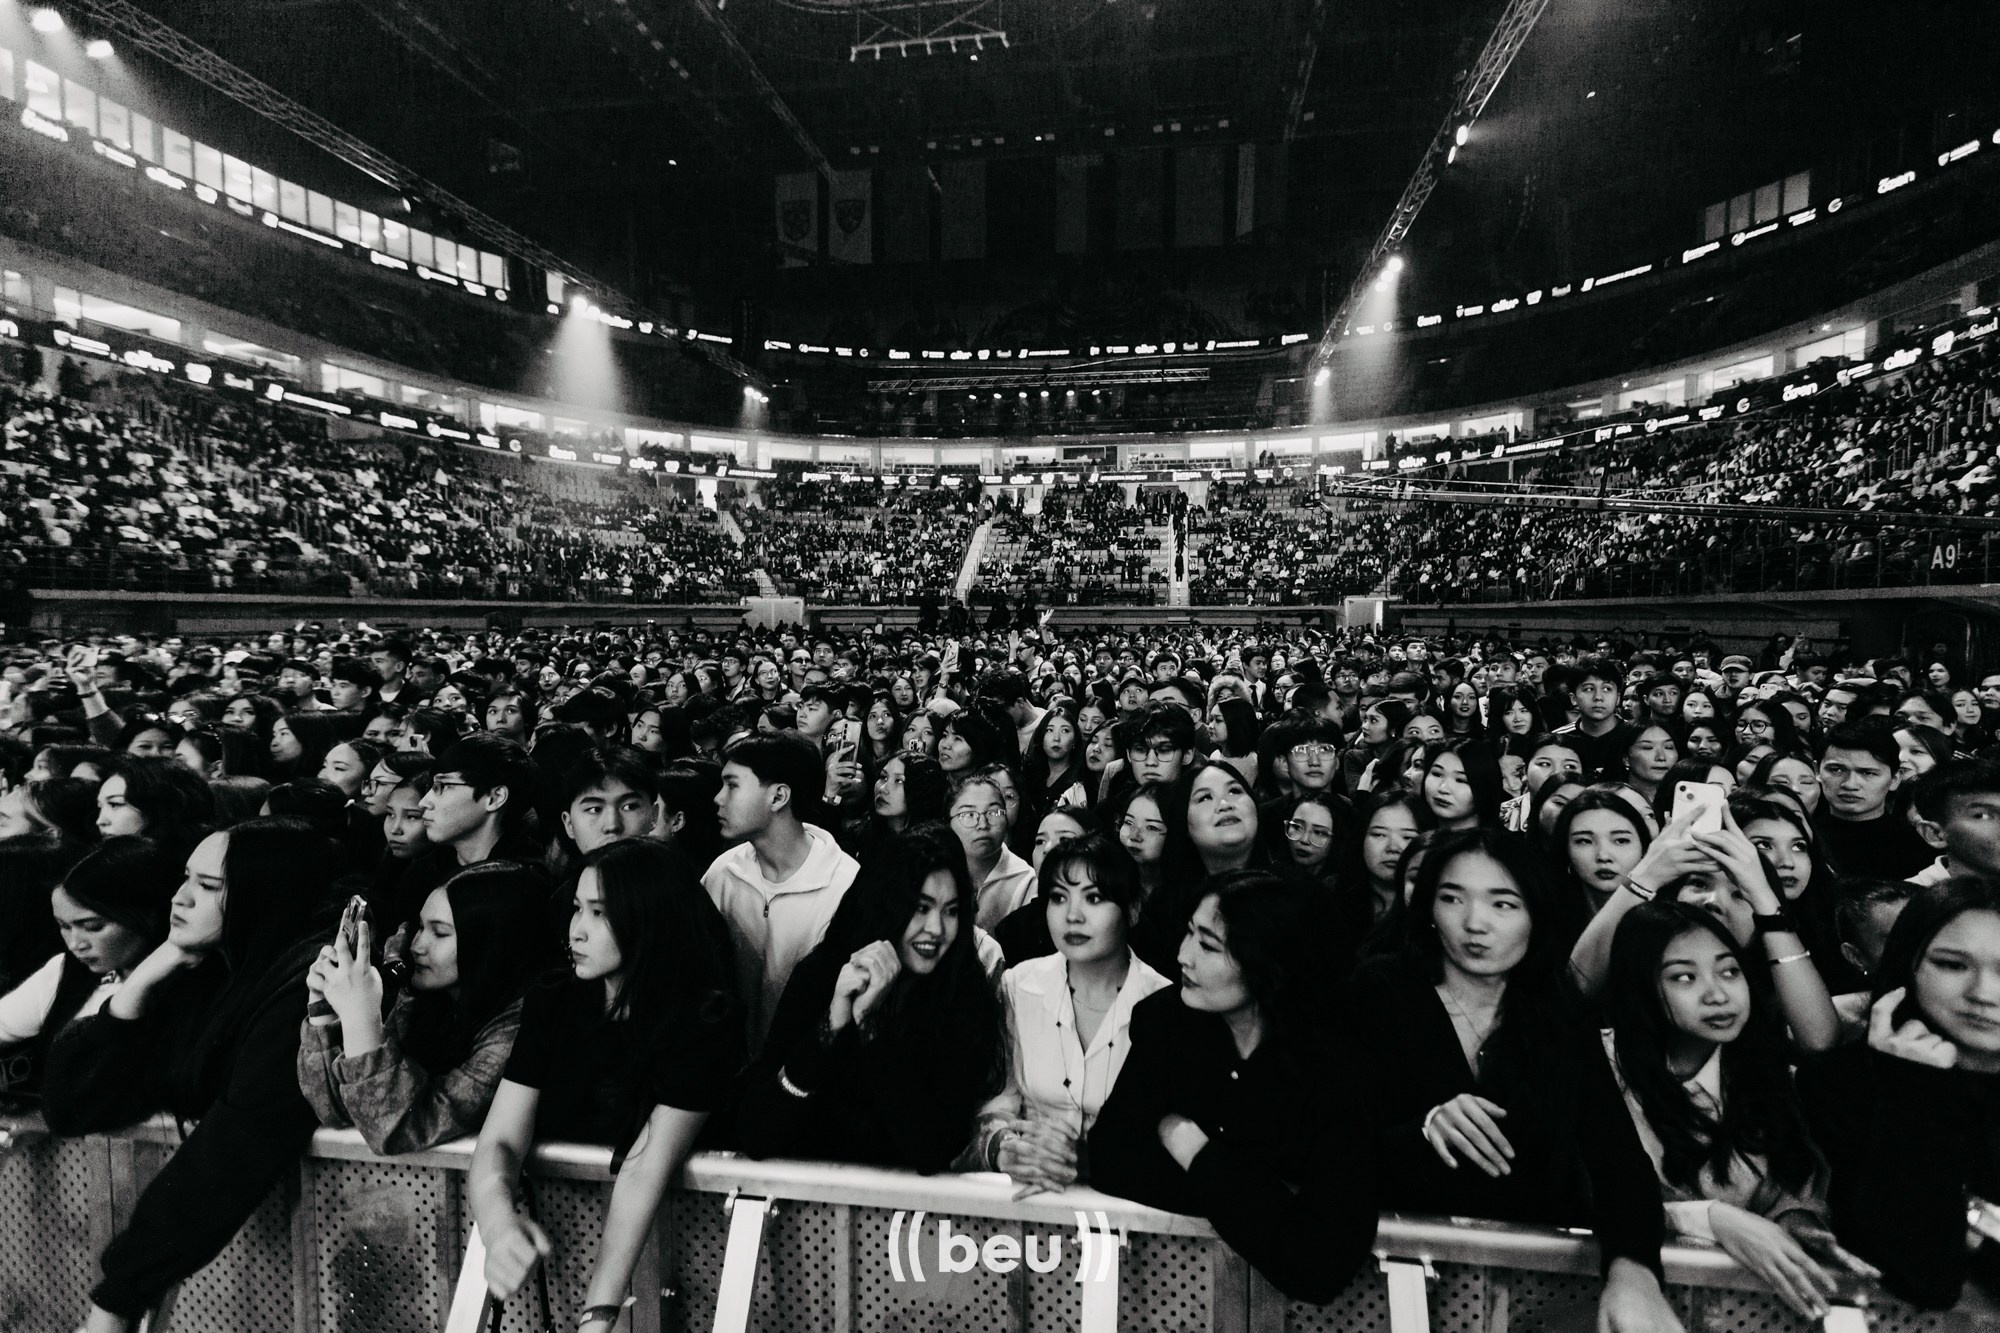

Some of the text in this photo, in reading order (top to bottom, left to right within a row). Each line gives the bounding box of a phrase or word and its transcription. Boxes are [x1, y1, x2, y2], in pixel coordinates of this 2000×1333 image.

[1398, 455, 1427, 469] allur
[1930, 544, 1956, 570] A9
[508, 582, 520, 595] A2
[1269, 592, 1280, 603] A6
